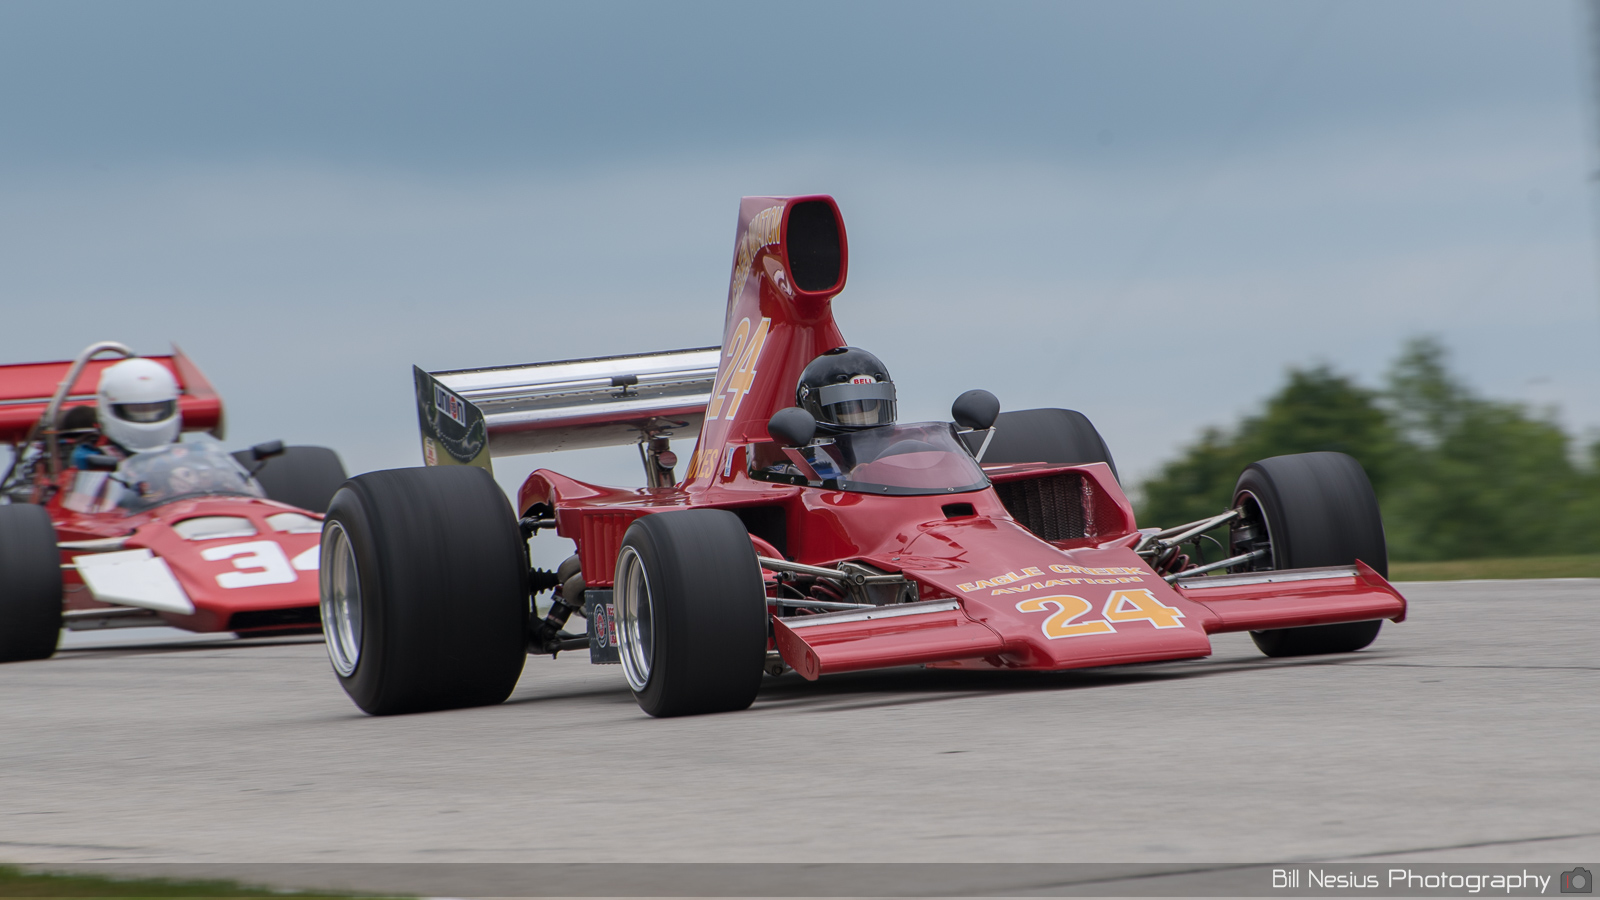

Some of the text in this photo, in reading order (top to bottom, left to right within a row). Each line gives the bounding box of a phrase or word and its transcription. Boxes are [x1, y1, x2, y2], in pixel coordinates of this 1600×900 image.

[706, 317, 771, 420] 24
[956, 564, 1152, 593] EAGLE CREEK
[990, 576, 1144, 596] AVIATION
[1015, 588, 1187, 640] 24
